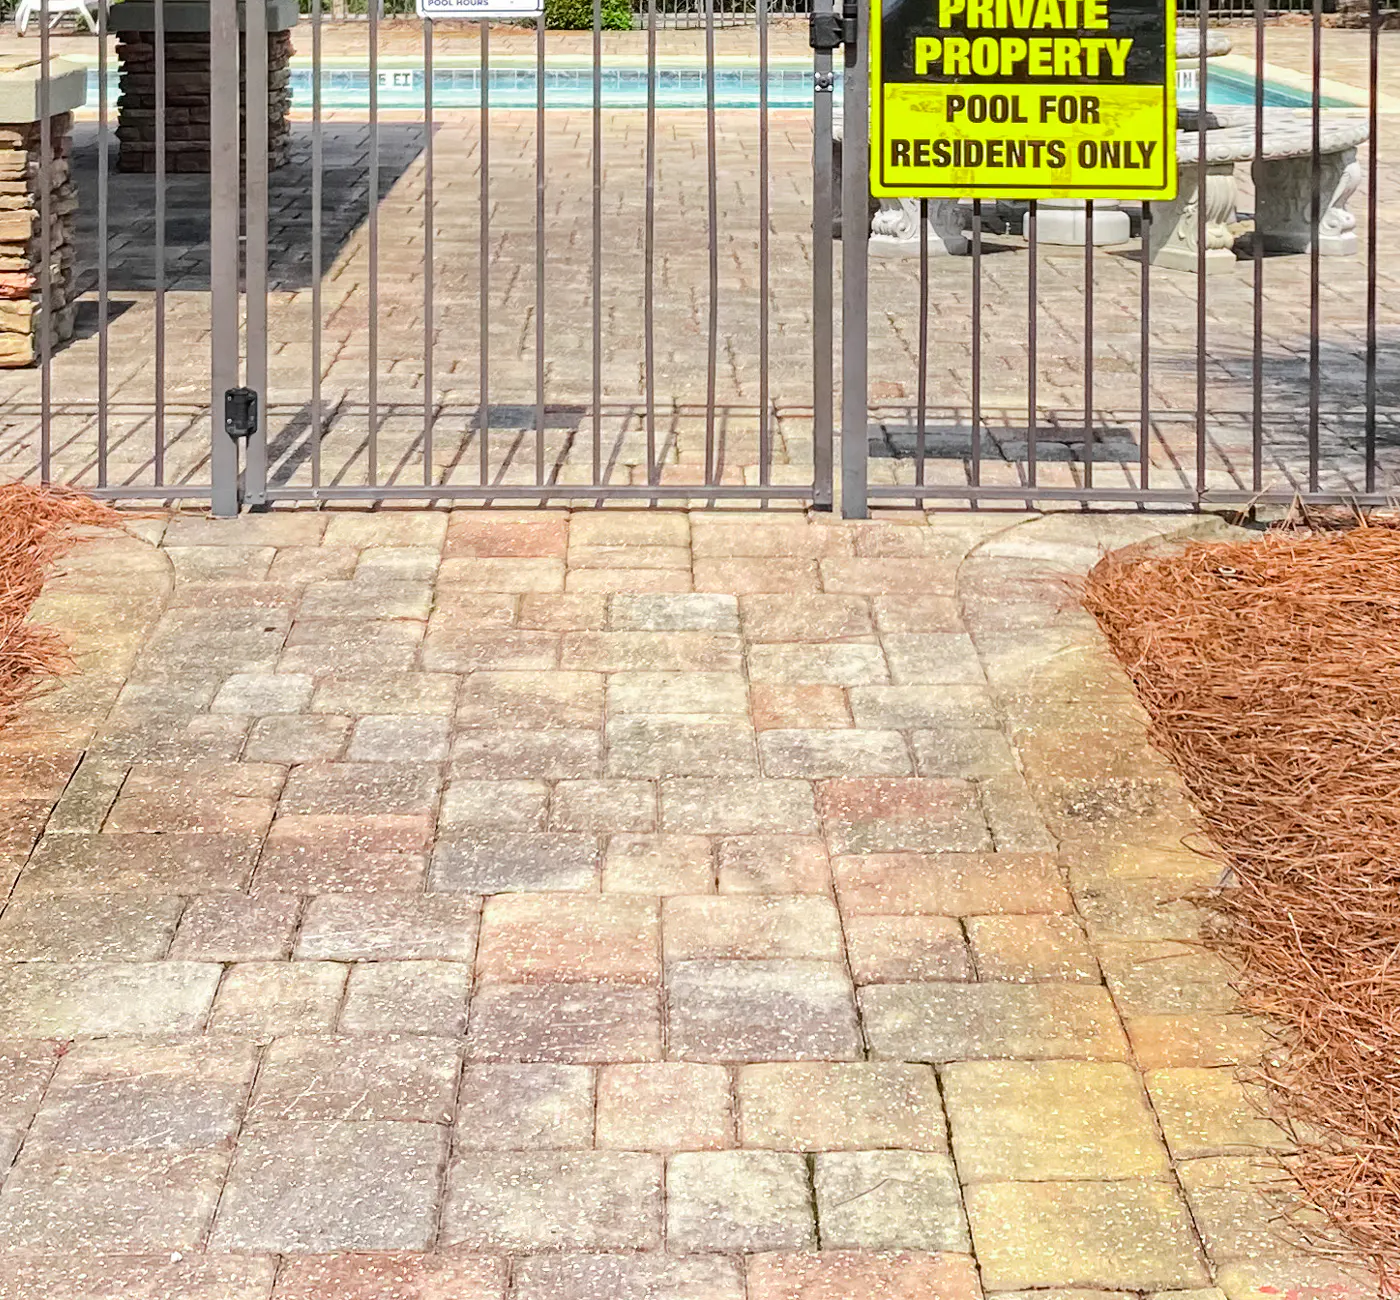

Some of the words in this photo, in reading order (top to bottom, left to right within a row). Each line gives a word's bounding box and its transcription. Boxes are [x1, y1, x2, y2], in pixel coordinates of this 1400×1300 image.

[914, 36, 1134, 76] PROPERTY
[946, 94, 1028, 124] POOL
[1039, 95, 1101, 124] FOR
[890, 138, 1067, 169] RESIDENTS
[1077, 140, 1159, 170] ONLY
